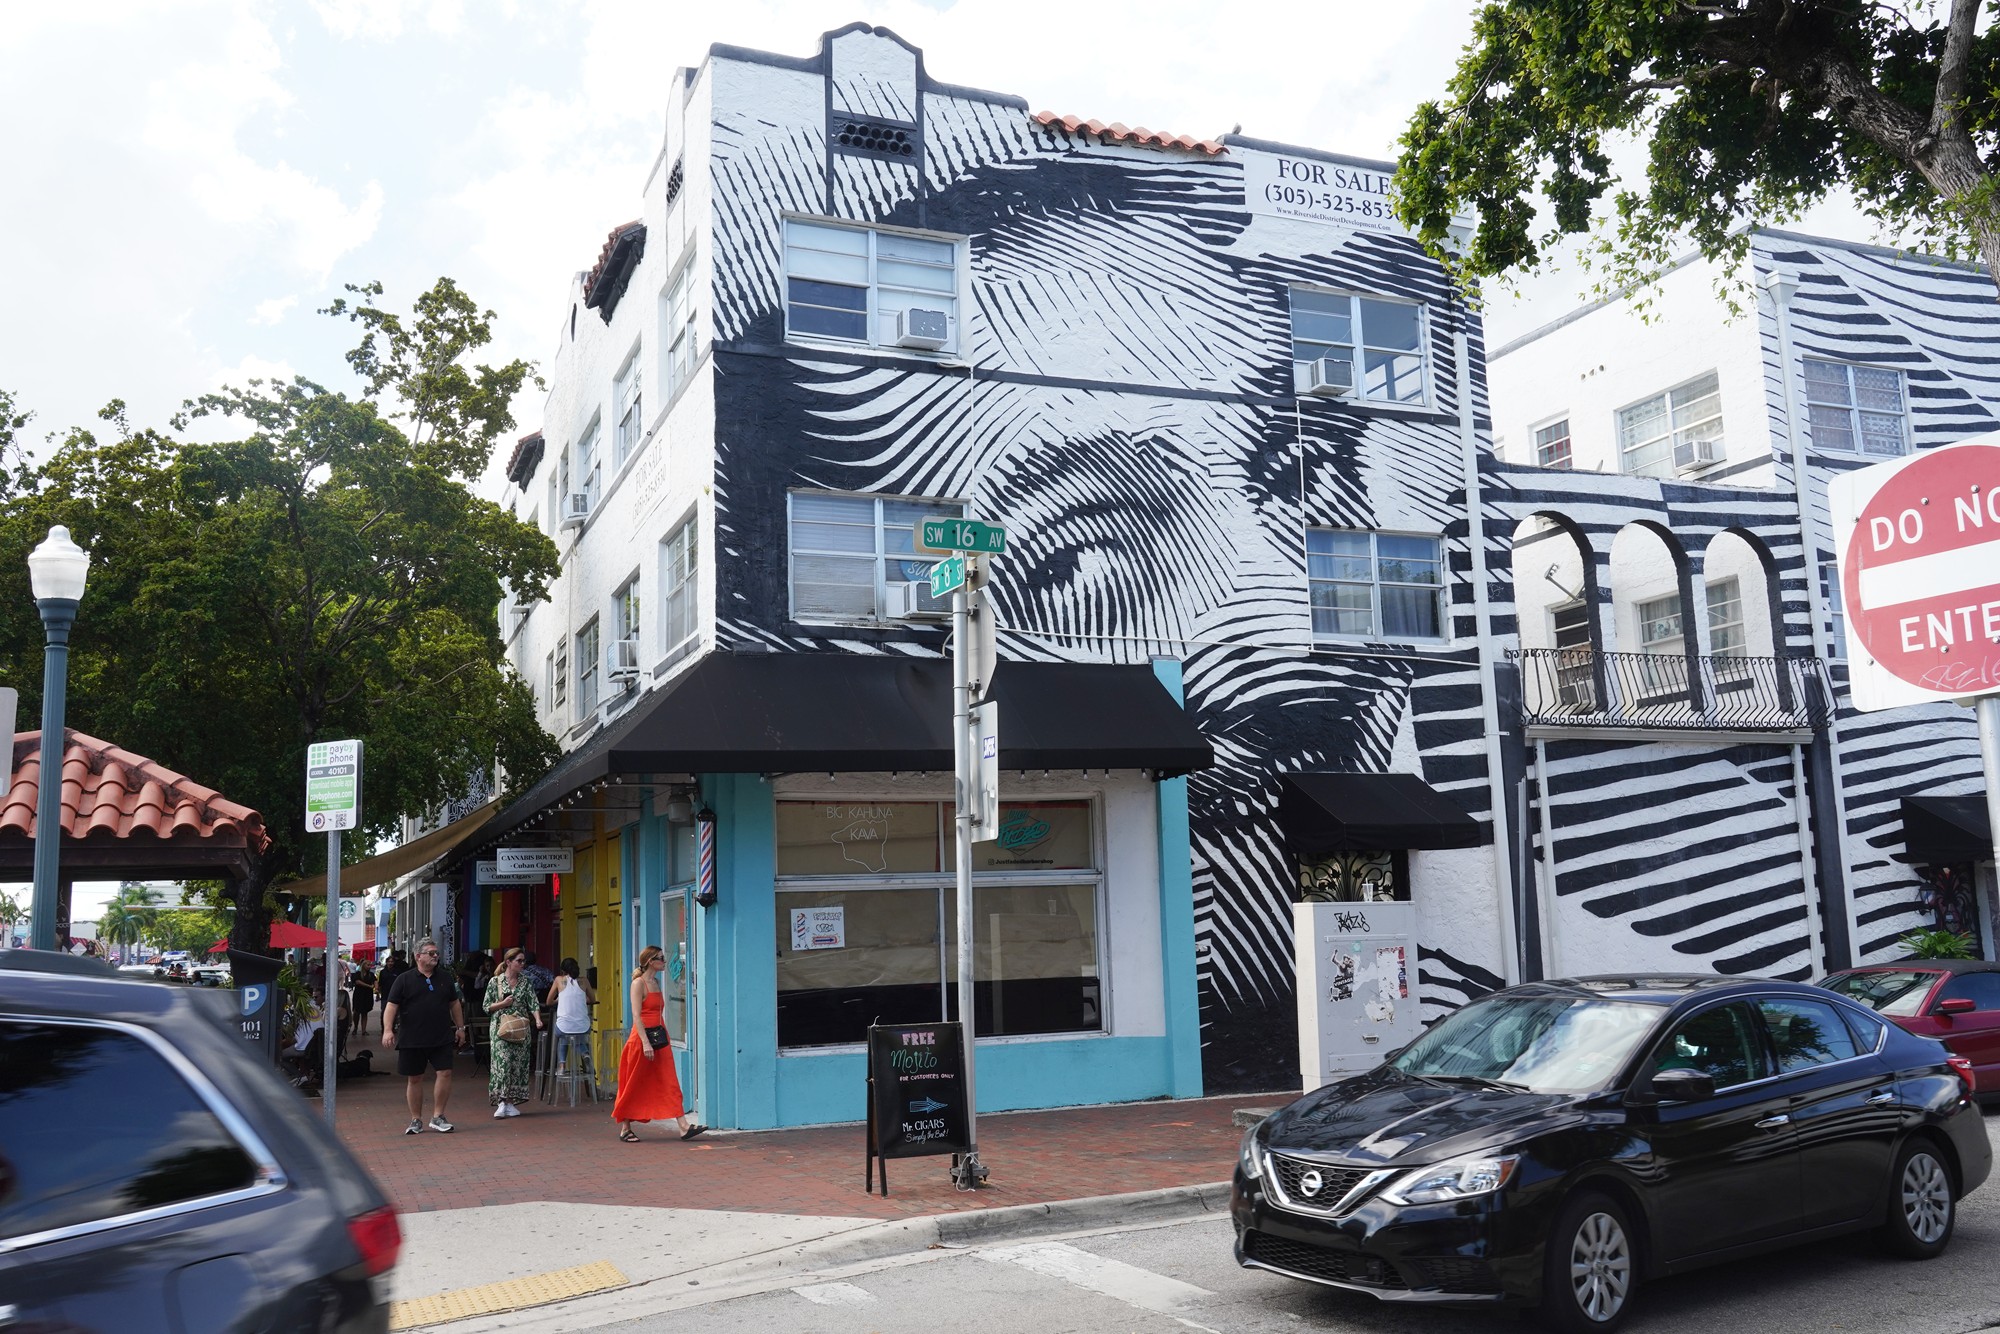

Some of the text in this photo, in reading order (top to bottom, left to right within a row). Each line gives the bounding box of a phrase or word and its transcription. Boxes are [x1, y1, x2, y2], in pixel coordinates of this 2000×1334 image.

[1277, 158, 1391, 196] FOR SALE
[1265, 183, 1400, 221] (305)-525-853
[1870, 486, 2000, 552] DO NO
[927, 523, 1002, 548] SW 16 AV
[932, 563, 963, 592] SW 8 ST
[1899, 600, 2000, 653] ENTE
[330, 754, 354, 765] phone
[328, 767, 347, 775] 40101
[330, 780, 344, 788] mobile
[345, 780, 353, 788] app
[310, 791, 353, 802] paybyphone.com
[827, 807, 893, 818] BIG KAHUNA
[850, 828, 878, 840] KAVA
[244, 987, 260, 1010] P
[241, 1021, 261, 1033] 101
[902, 1032, 936, 1046] FREE
[891, 1047, 937, 1073] Mojito
[914, 1118, 945, 1131] CIGARS
[904, 1130, 927, 1145] Simply
